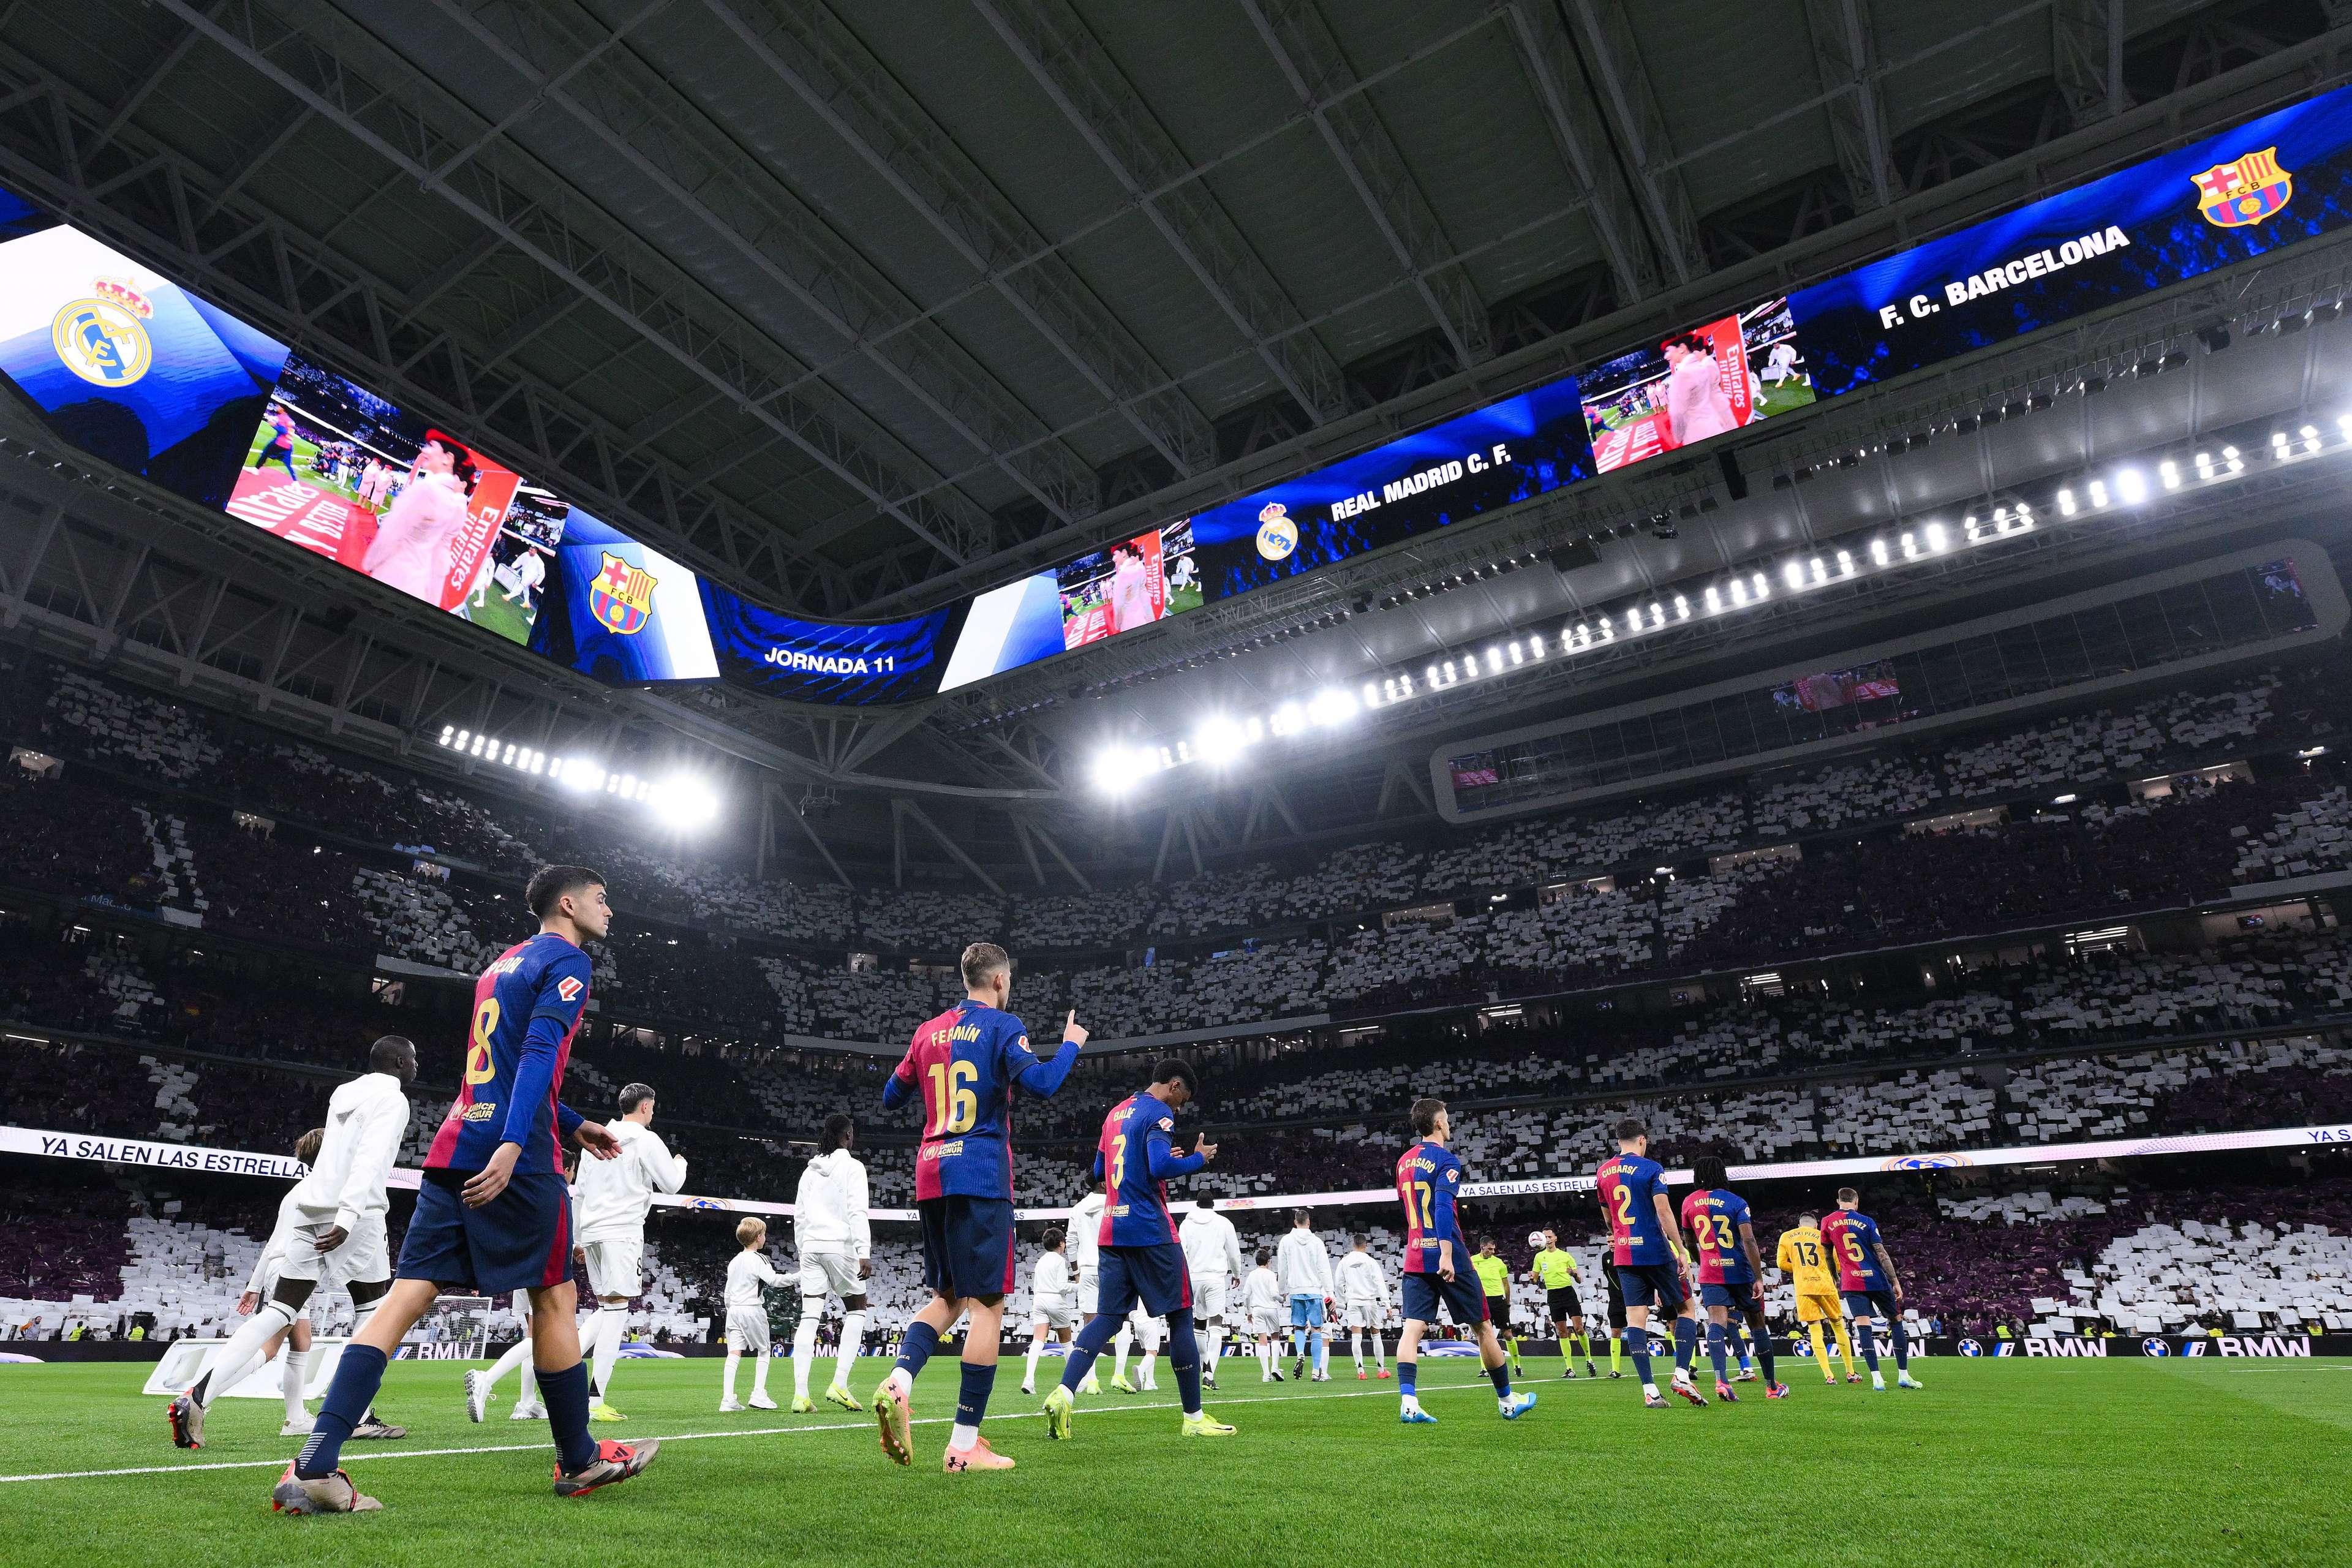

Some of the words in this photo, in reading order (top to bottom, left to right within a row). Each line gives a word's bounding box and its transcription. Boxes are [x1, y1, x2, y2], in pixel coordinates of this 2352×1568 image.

[1879, 304, 1904, 330] F.
[1910, 293, 1940, 318] C.
[1945, 225, 2130, 306] BARCELONA
[1727, 344, 1745, 408] Emirates
[1331, 491, 1381, 522] REAL
[1383, 460, 1463, 503] MADRID
[1467, 453, 1489, 474] C.
[1493, 443, 1511, 466] F.
[451, 507, 500, 591] Emirates
[1152, 553, 1161, 606] Emirates
[611, 587, 633, 604] FCB
[764, 647, 867, 674] JORNADA
[873, 655, 894, 671] 11
[466, 998, 500, 1085] 8
[932, 1023, 981, 1047] FERMÍN
[927, 1060, 978, 1136] 16
[2307, 1131, 2334, 1142] YA
[41, 1137, 68, 1155] YA
[76, 1141, 151, 1163] SALEN
[157, 1150, 198, 1167] LAS
[1111, 1134, 1126, 1189] 3
[1462, 1187, 1476, 1196] YA
[1479, 1185, 1515, 1195] SALEN
[1518, 1183, 1539, 1193] LAS
[1542, 1180, 1597, 1192] ESTRELLA
[1401, 1181, 1433, 1229] 17
[1613, 1185, 1636, 1225] 2
[1694, 1215, 1734, 1250] 23
[1842, 1233, 1864, 1262] 5
[637, 1257, 643, 1276] 8
[1794, 1242, 1819, 1267] 13
[417, 1342, 475, 1360] BMW
[2024, 1338, 2107, 1357] BMW
[2216, 1337, 2311, 1357] BMW
